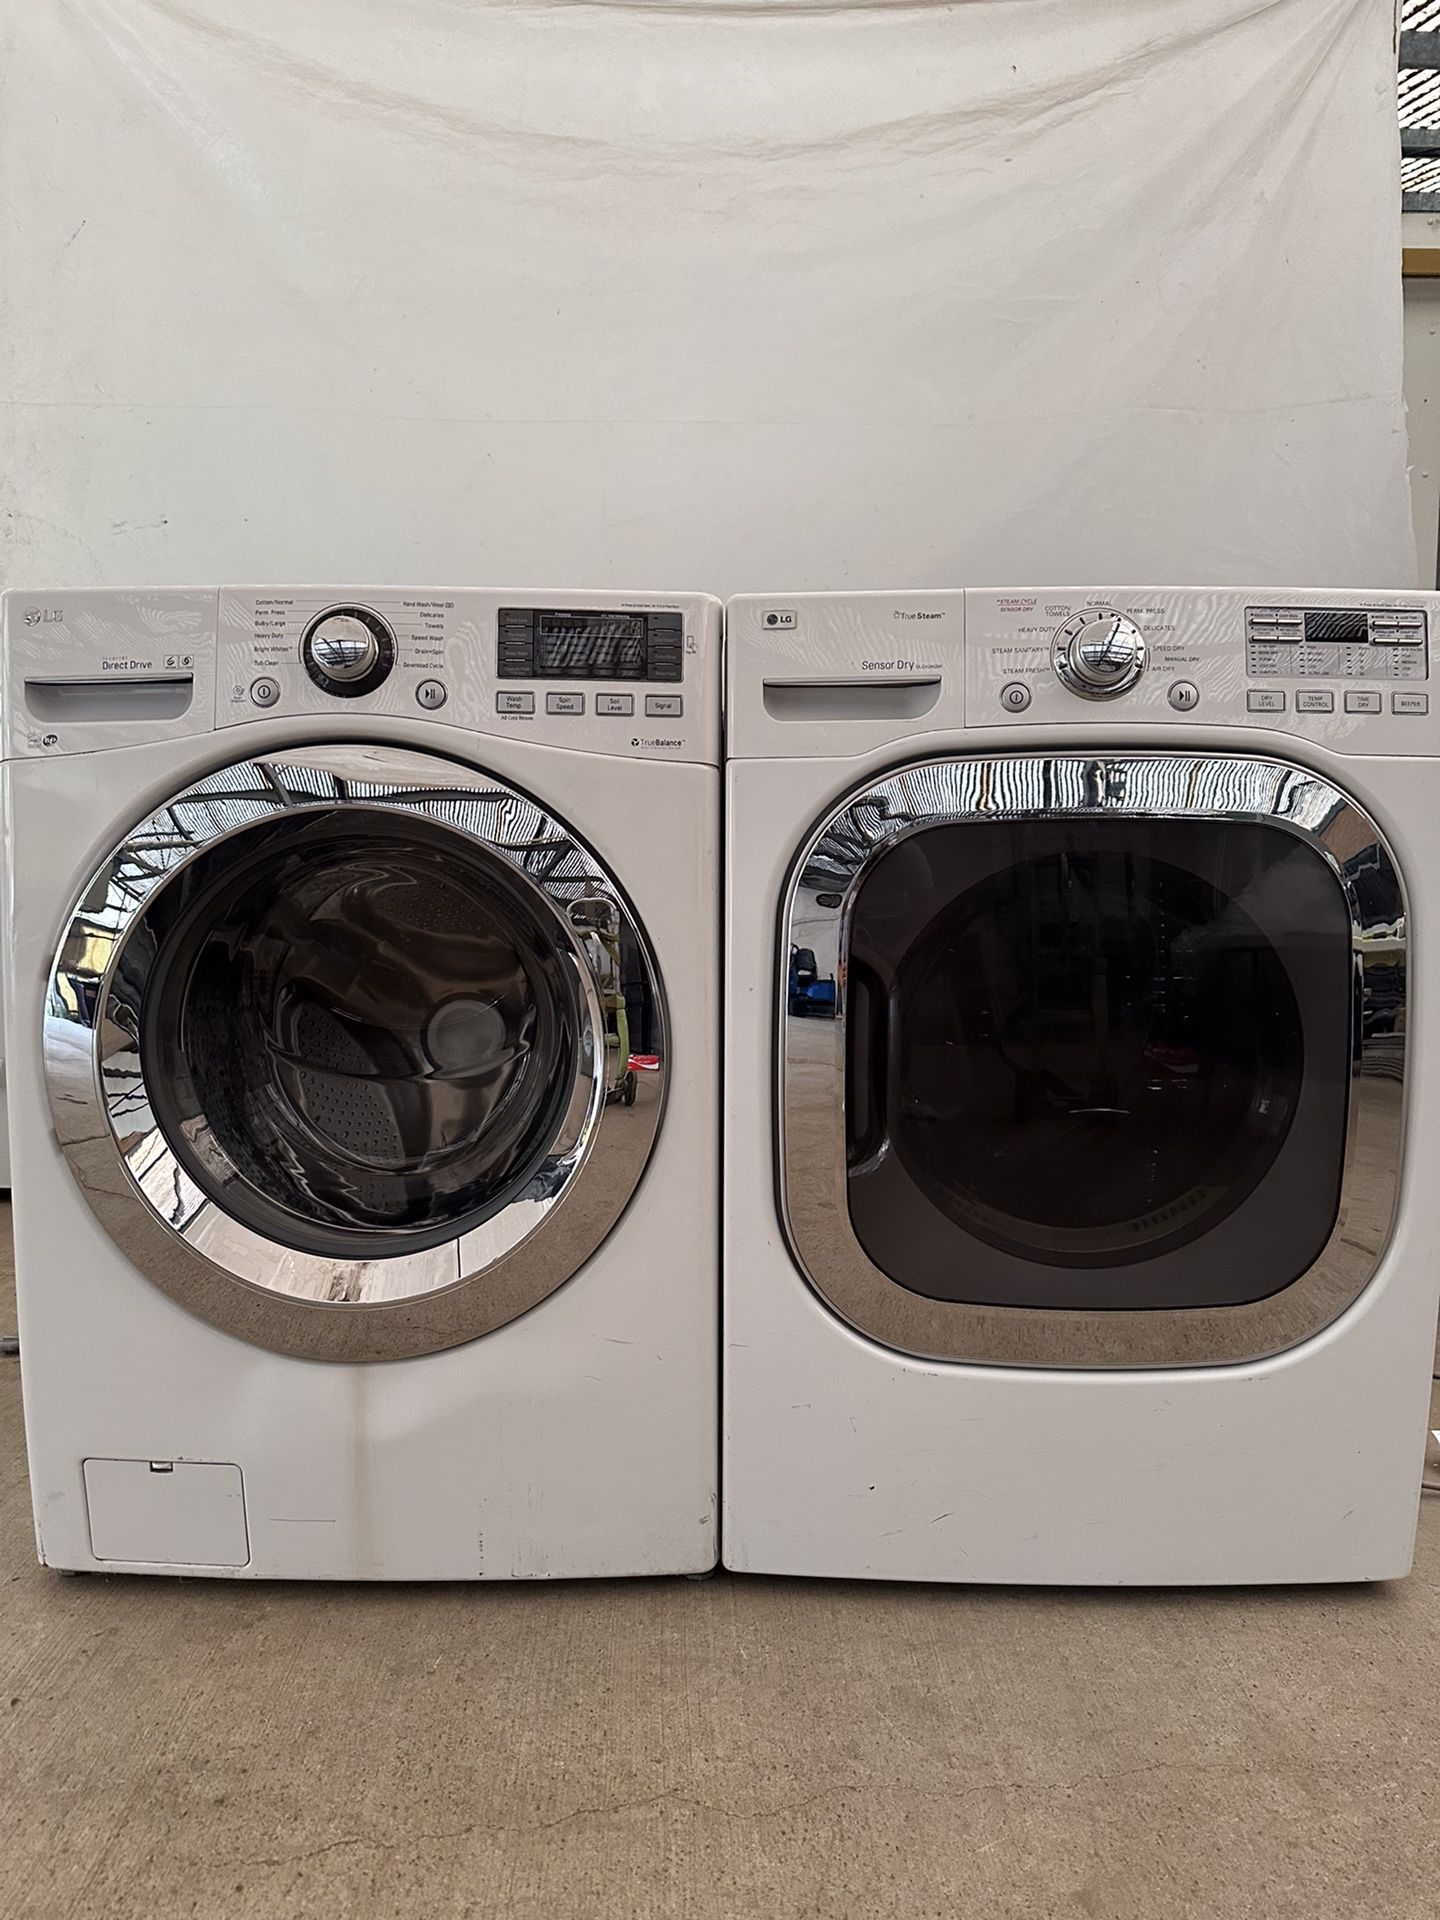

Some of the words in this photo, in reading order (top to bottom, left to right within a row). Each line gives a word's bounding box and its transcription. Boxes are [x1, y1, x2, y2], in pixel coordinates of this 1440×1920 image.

[43, 609, 64, 623] LG
[102, 661, 128, 670] Direct
[130, 661, 152, 670] Drive
[862, 660, 895, 670] Sensor
[897, 660, 915, 671] Dry
[556, 703, 574, 711] Speed
[655, 702, 672, 710] Signal
